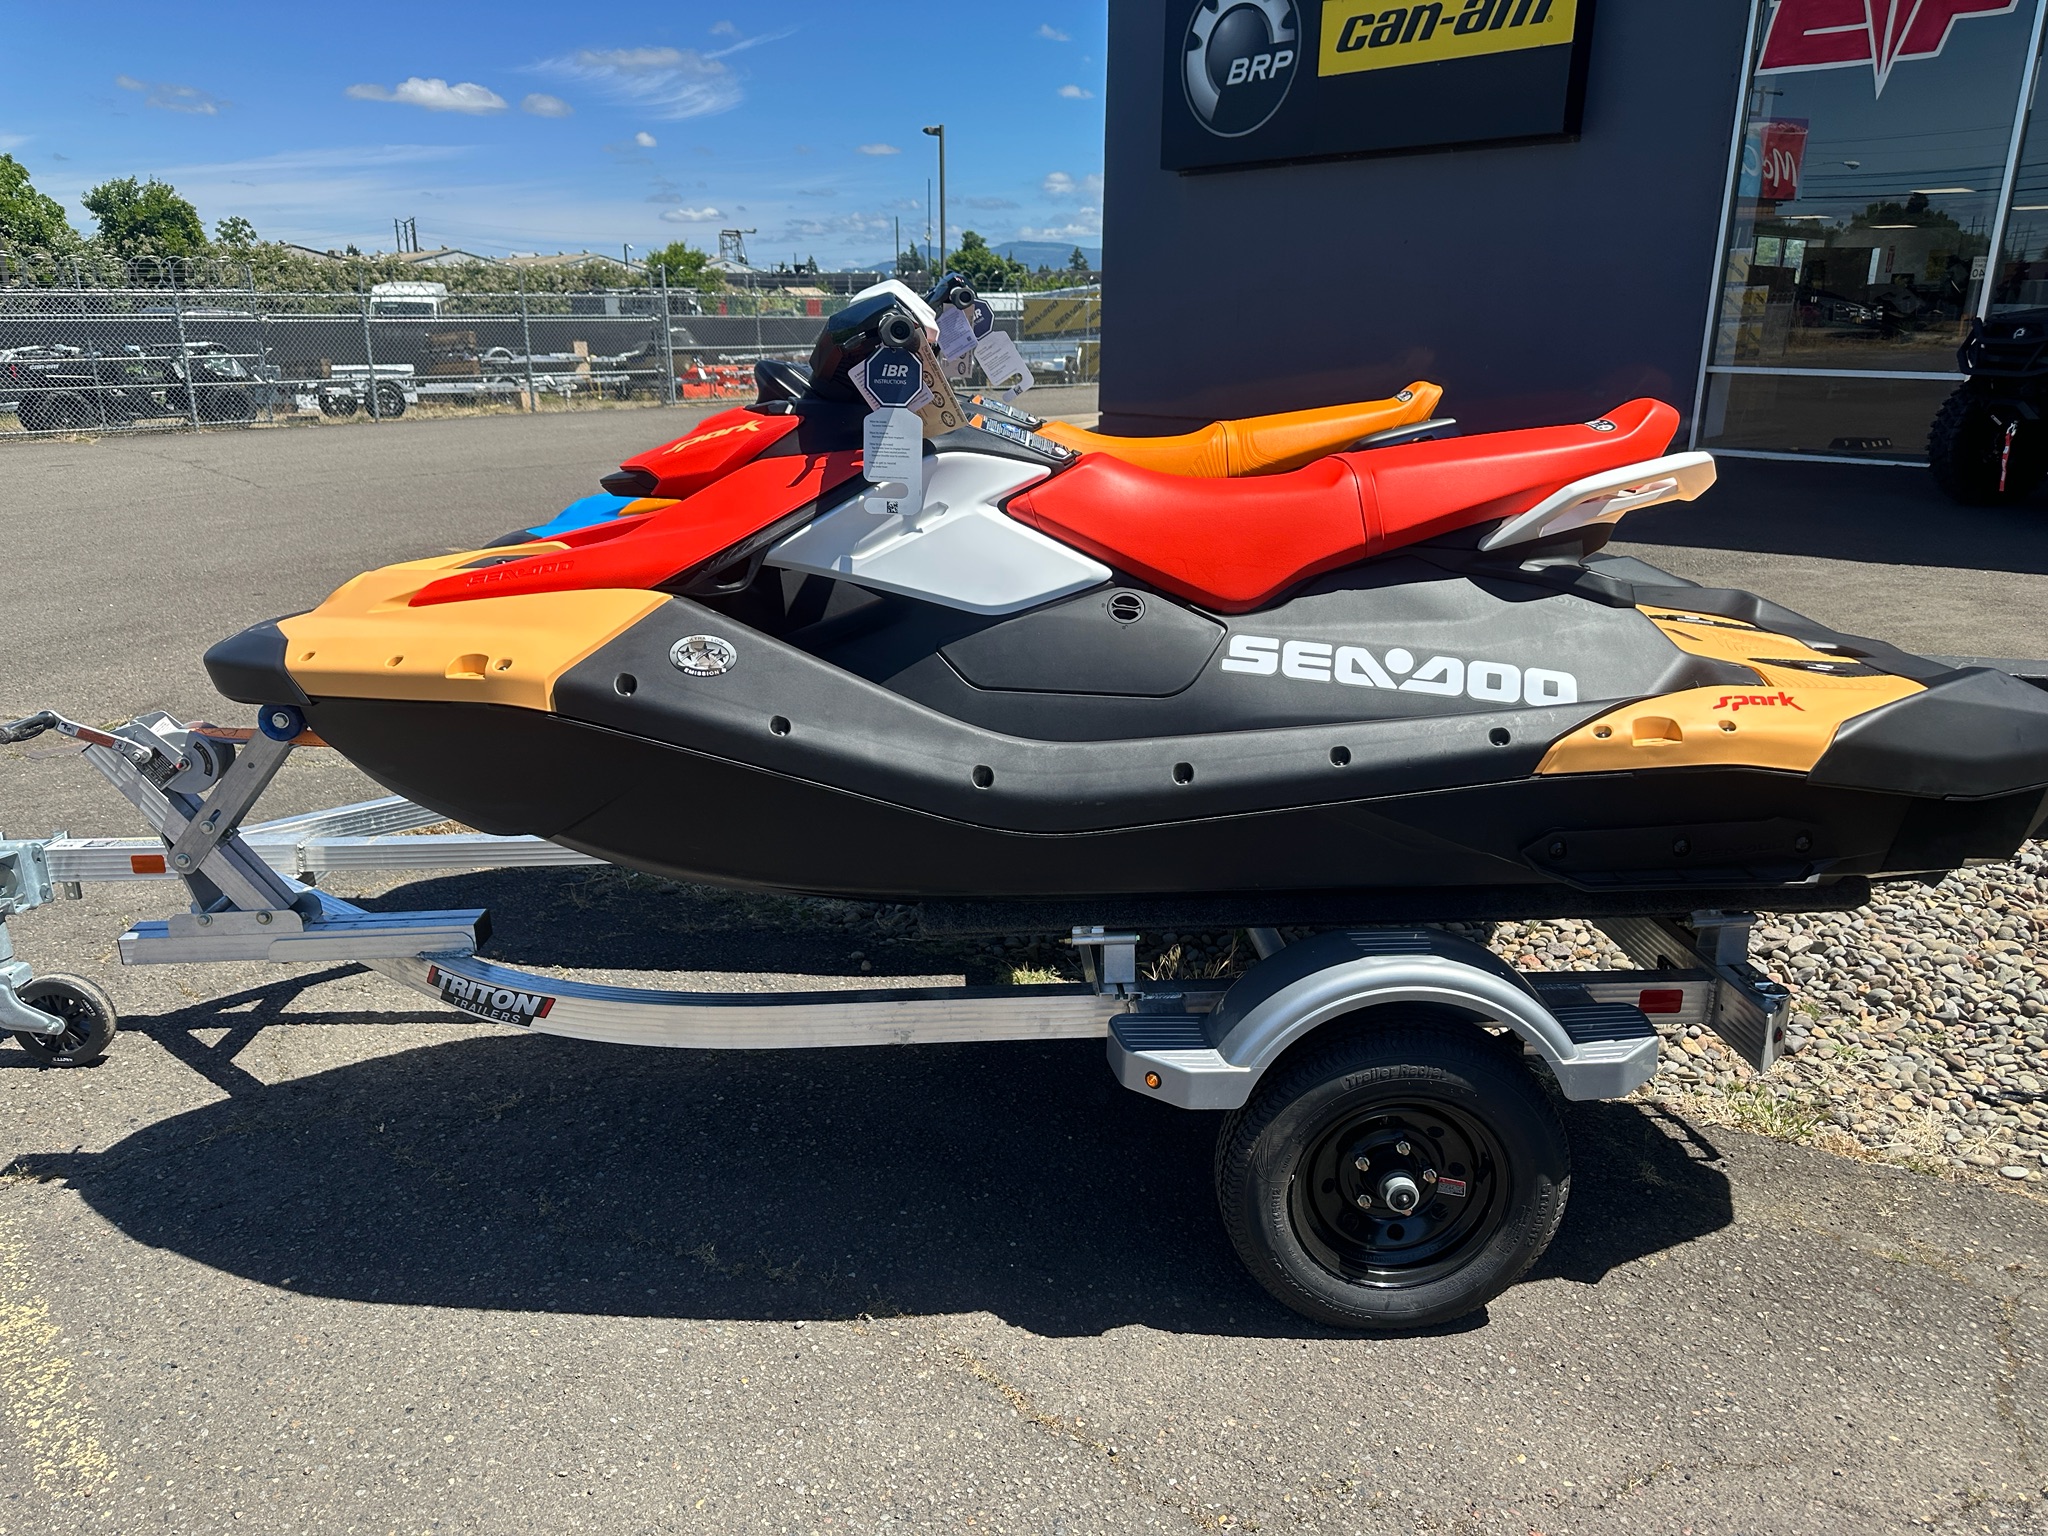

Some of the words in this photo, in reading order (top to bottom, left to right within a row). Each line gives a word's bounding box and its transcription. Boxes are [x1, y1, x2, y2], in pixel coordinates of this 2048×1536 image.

[1226, 49, 1294, 86] BRP
[881, 364, 909, 377] iBR
[684, 667, 720, 677] EMISSION
[438, 969, 541, 1016] TRITON
[453, 997, 521, 1024] TRAILERS
[1344, 1064, 1399, 1087] Trailer
[1400, 1063, 1447, 1080] Radial
